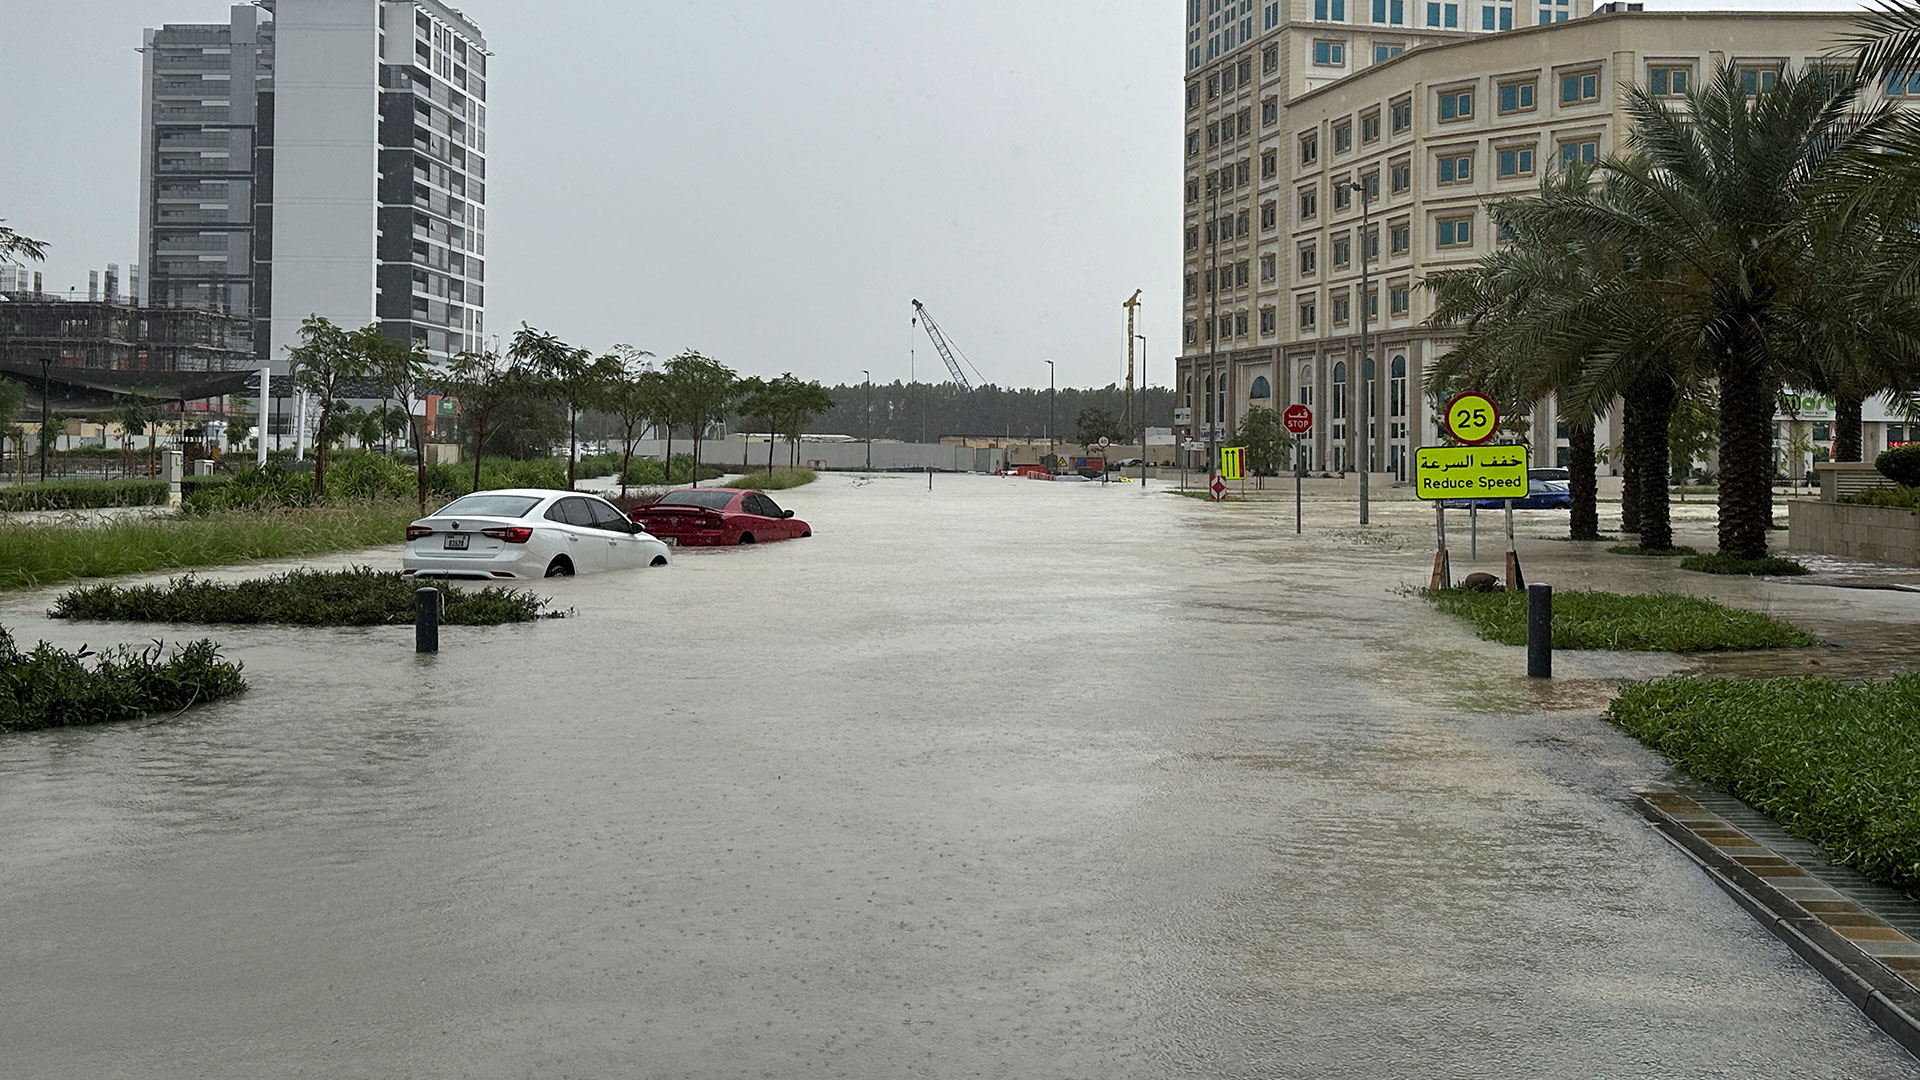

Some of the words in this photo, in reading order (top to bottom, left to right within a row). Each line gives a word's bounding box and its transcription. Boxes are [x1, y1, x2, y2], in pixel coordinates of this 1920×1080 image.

[1288, 408, 1308, 418] قف
[1457, 408, 1487, 428] 25
[1287, 419, 1309, 428] STOP
[1420, 453, 1474, 472] السرعة
[1480, 454, 1523, 467] خفف
[1423, 477, 1474, 489] Reduce
[1478, 475, 1521, 490] Speed
